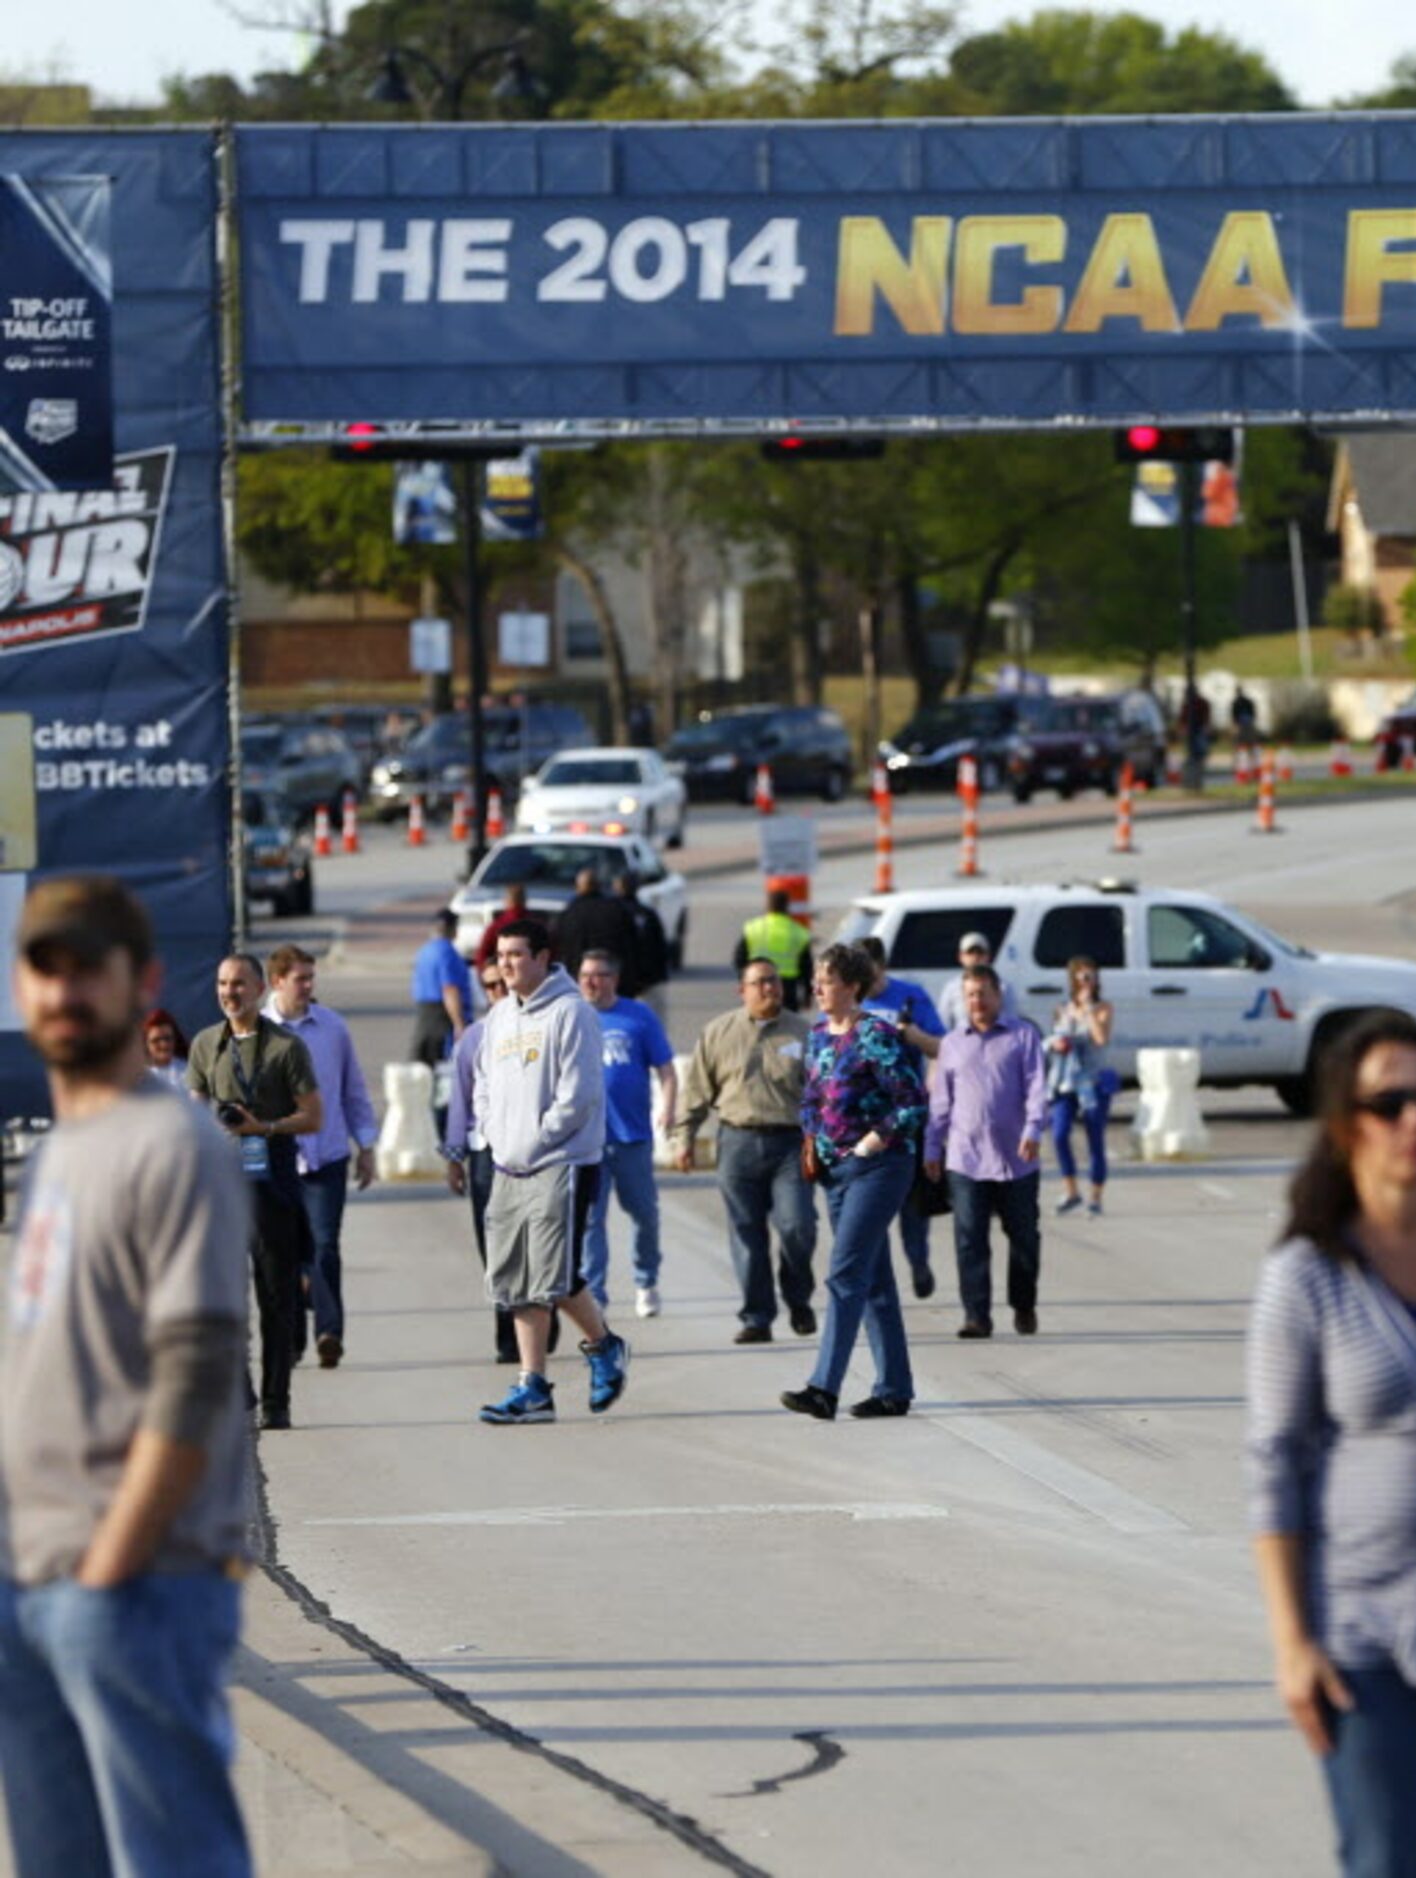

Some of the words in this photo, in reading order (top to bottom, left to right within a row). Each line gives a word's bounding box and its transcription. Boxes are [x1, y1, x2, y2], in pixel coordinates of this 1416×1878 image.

[280, 219, 512, 304] THE
[537, 217, 806, 303] 2014
[835, 211, 1297, 337] NCAA
[10, 298, 88, 319] TIP-OFF
[1, 319, 95, 340] TAILGATE
[135, 720, 172, 748] at
